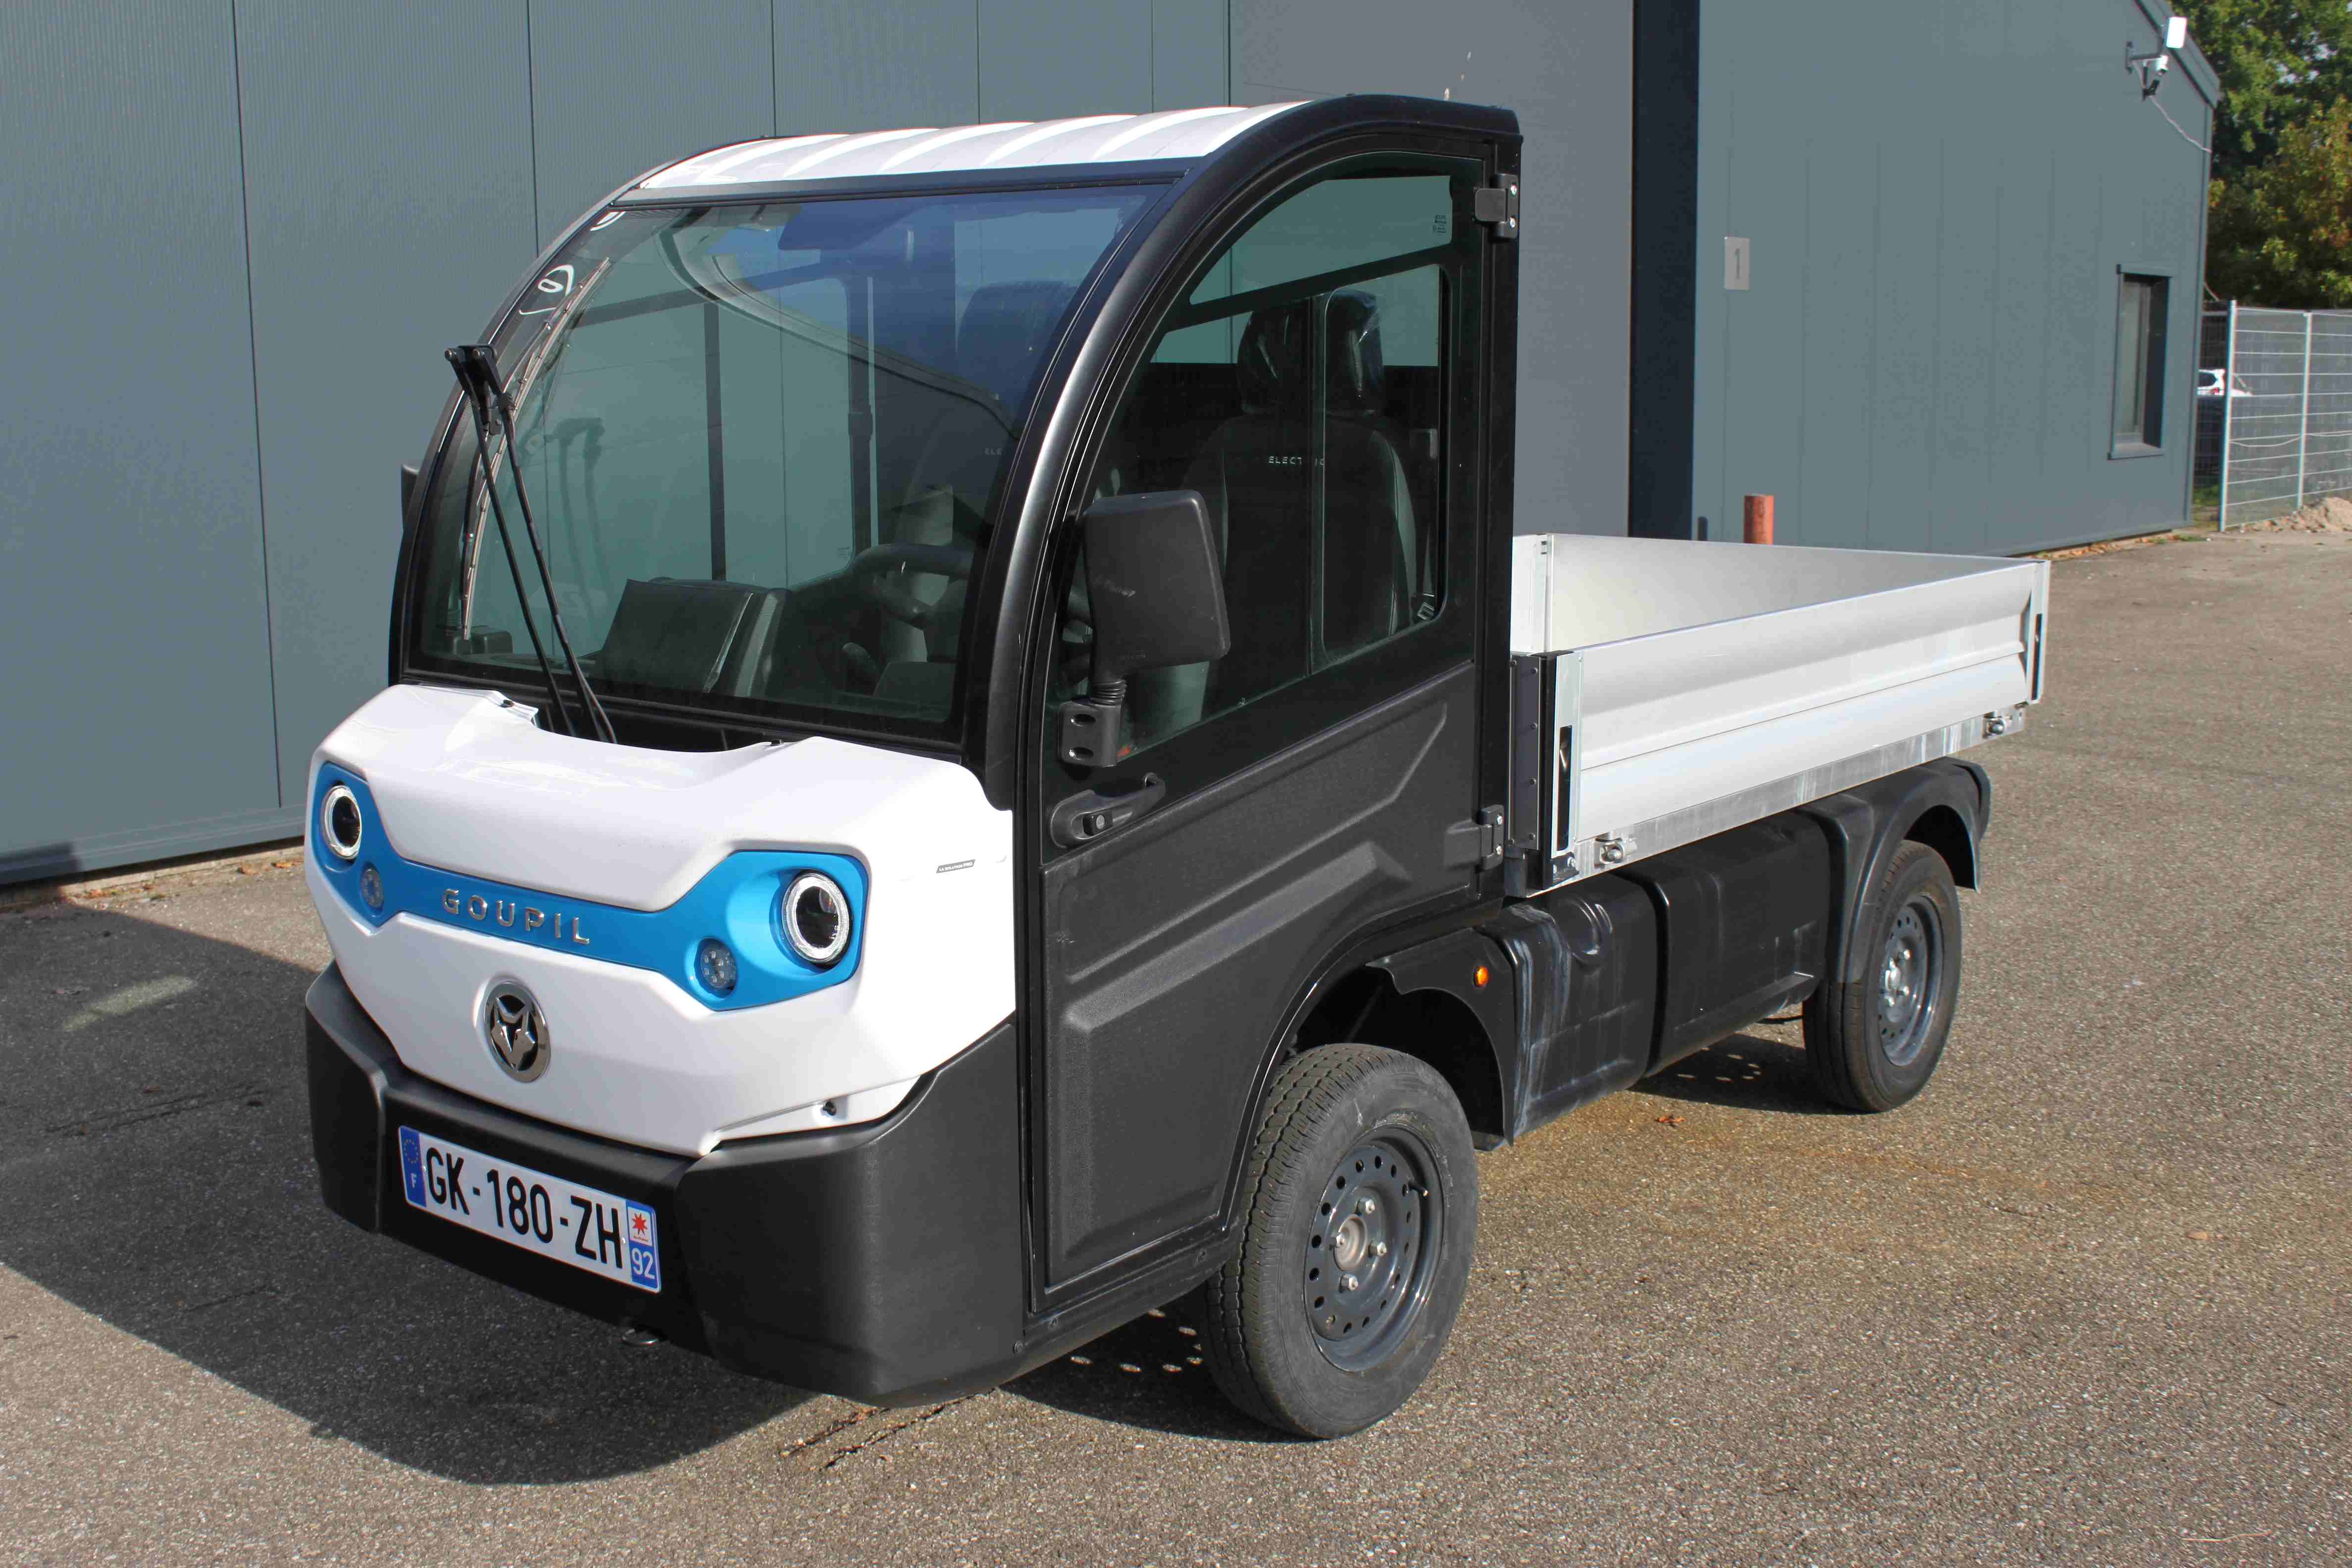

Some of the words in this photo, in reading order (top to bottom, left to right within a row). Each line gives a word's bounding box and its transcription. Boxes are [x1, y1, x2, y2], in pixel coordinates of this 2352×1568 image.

[442, 888, 590, 944] GOUPIL
[410, 1173, 417, 1188] F
[426, 1147, 623, 1269] GK-180-ZH
[632, 1248, 655, 1279] 92
